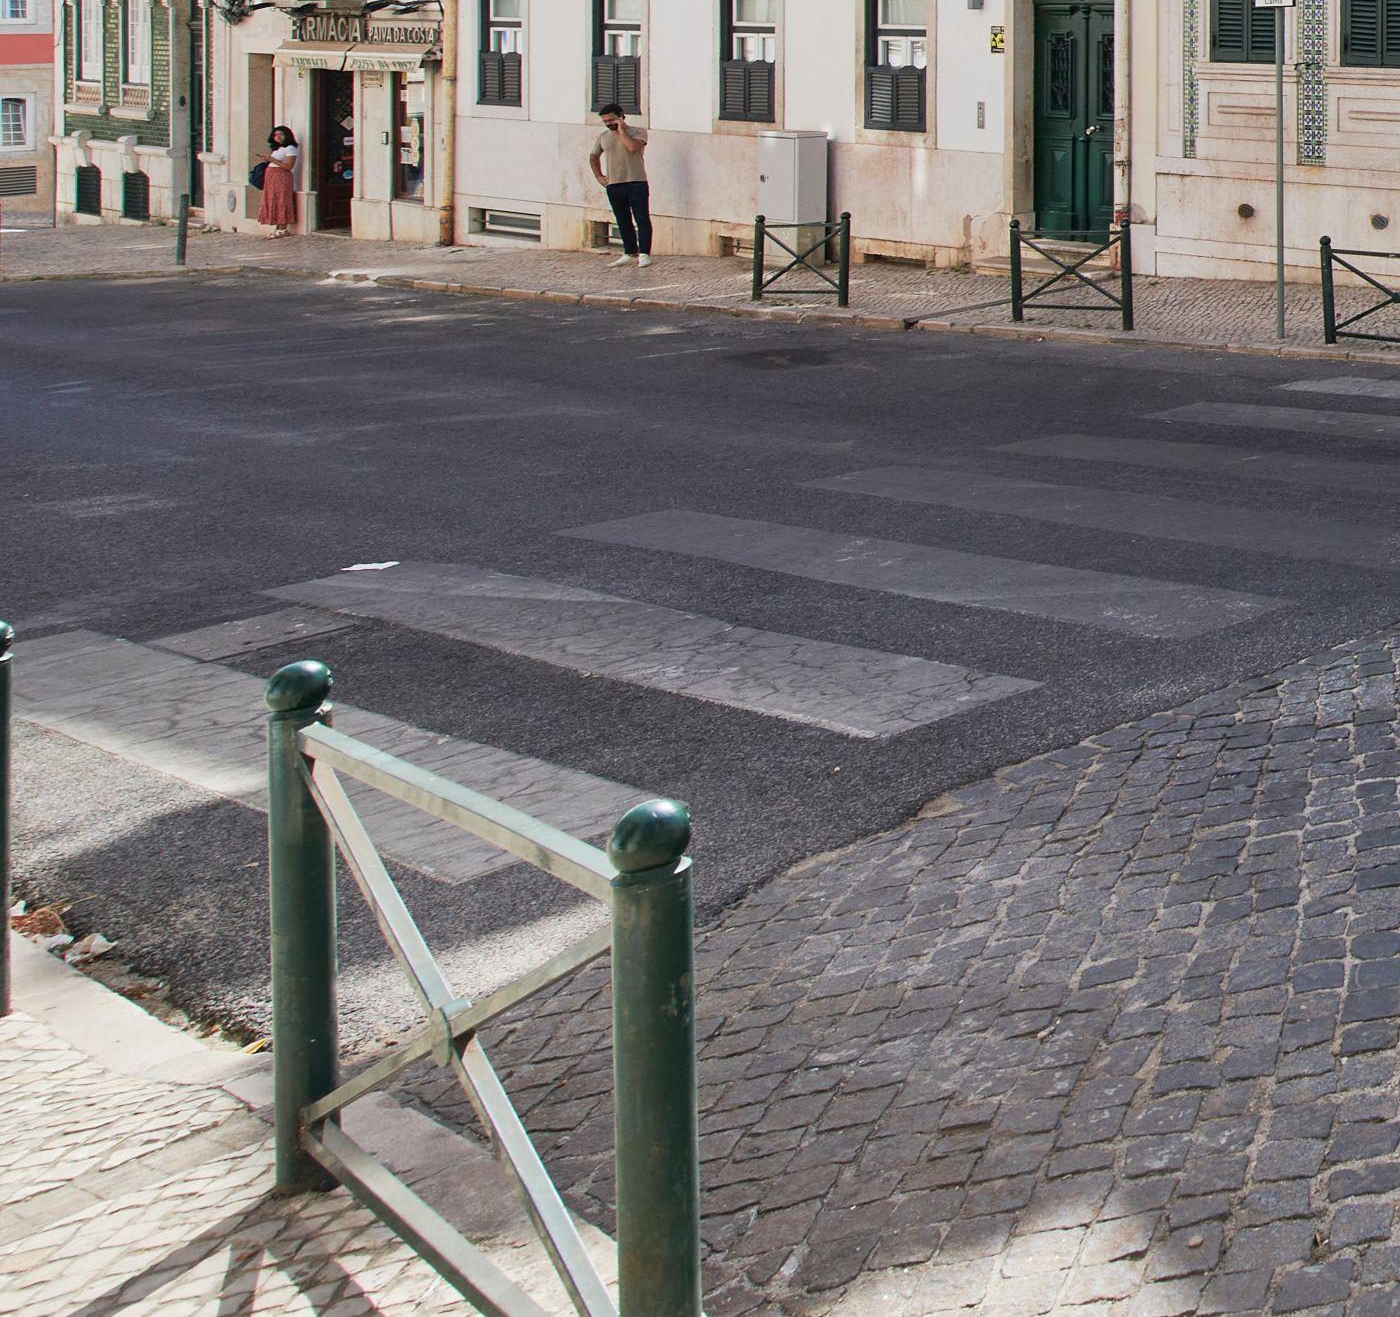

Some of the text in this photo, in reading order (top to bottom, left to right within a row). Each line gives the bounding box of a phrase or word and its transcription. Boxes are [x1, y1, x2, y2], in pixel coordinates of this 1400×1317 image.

[368, 27, 434, 44] PAIVA DA COSTA
